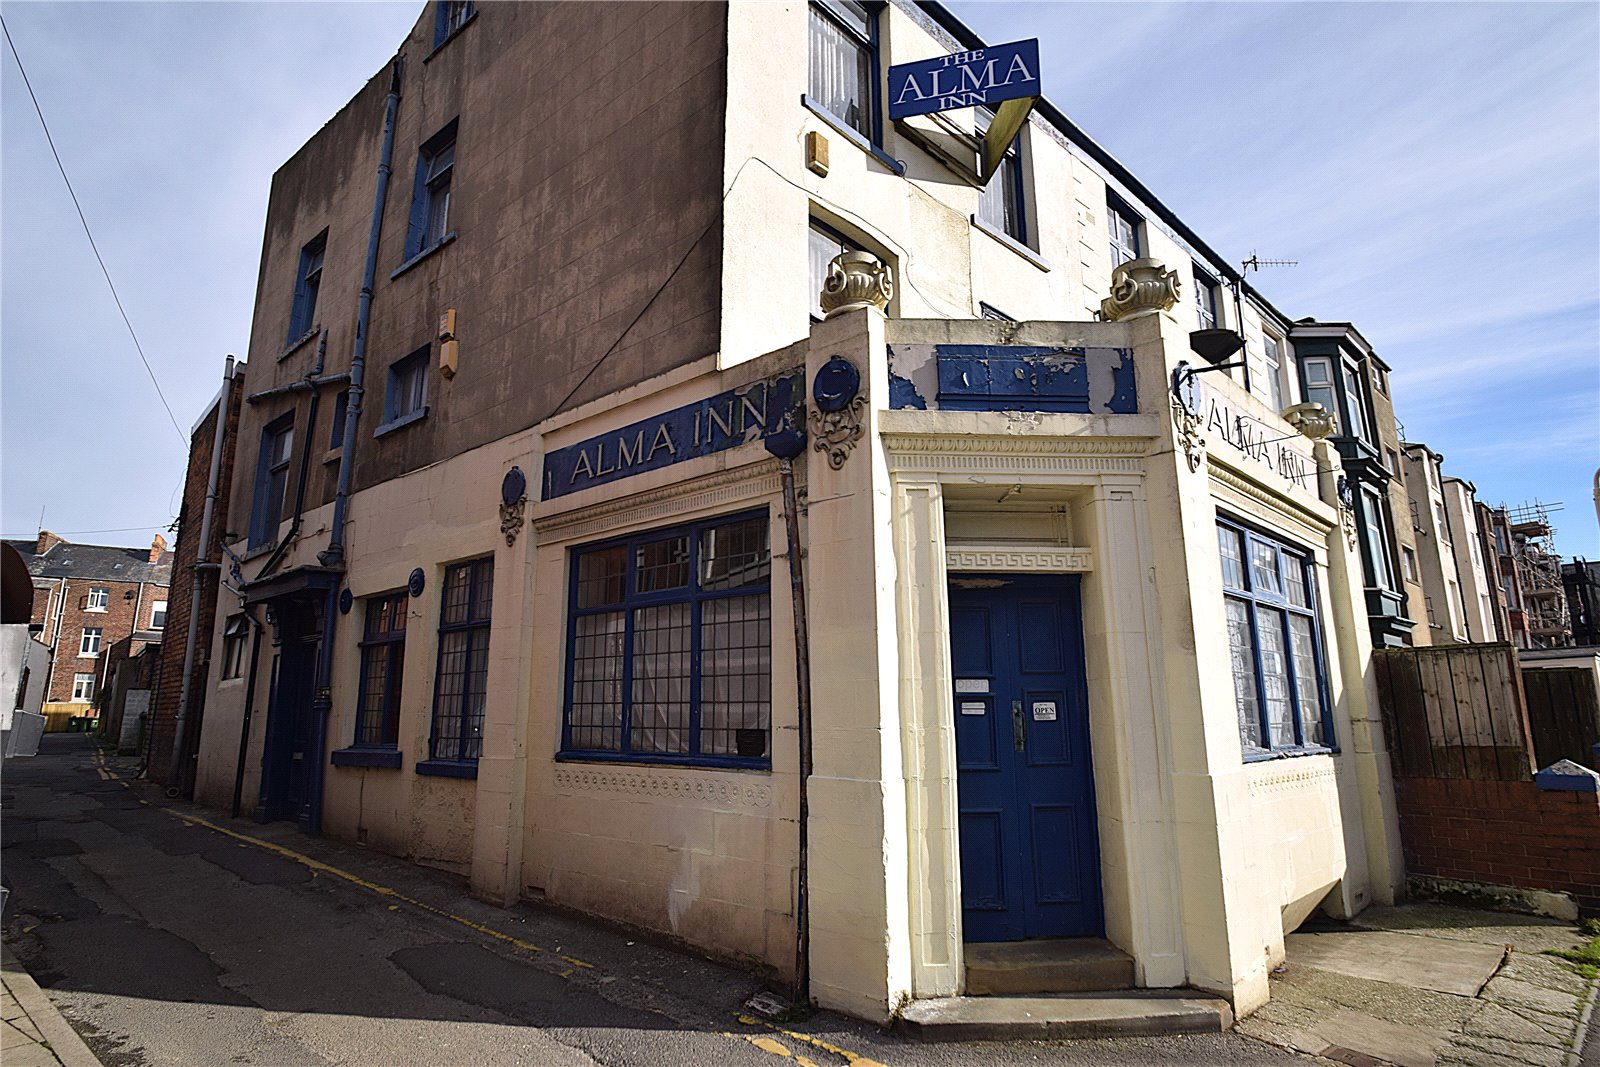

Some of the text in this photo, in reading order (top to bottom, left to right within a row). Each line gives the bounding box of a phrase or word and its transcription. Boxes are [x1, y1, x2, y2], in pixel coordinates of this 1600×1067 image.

[893, 53, 1036, 105] ALMA
[939, 50, 985, 67] THE
[938, 91, 986, 110] INN
[569, 391, 767, 484] ALMA INN
[1207, 398, 1307, 490] ALMA INN
